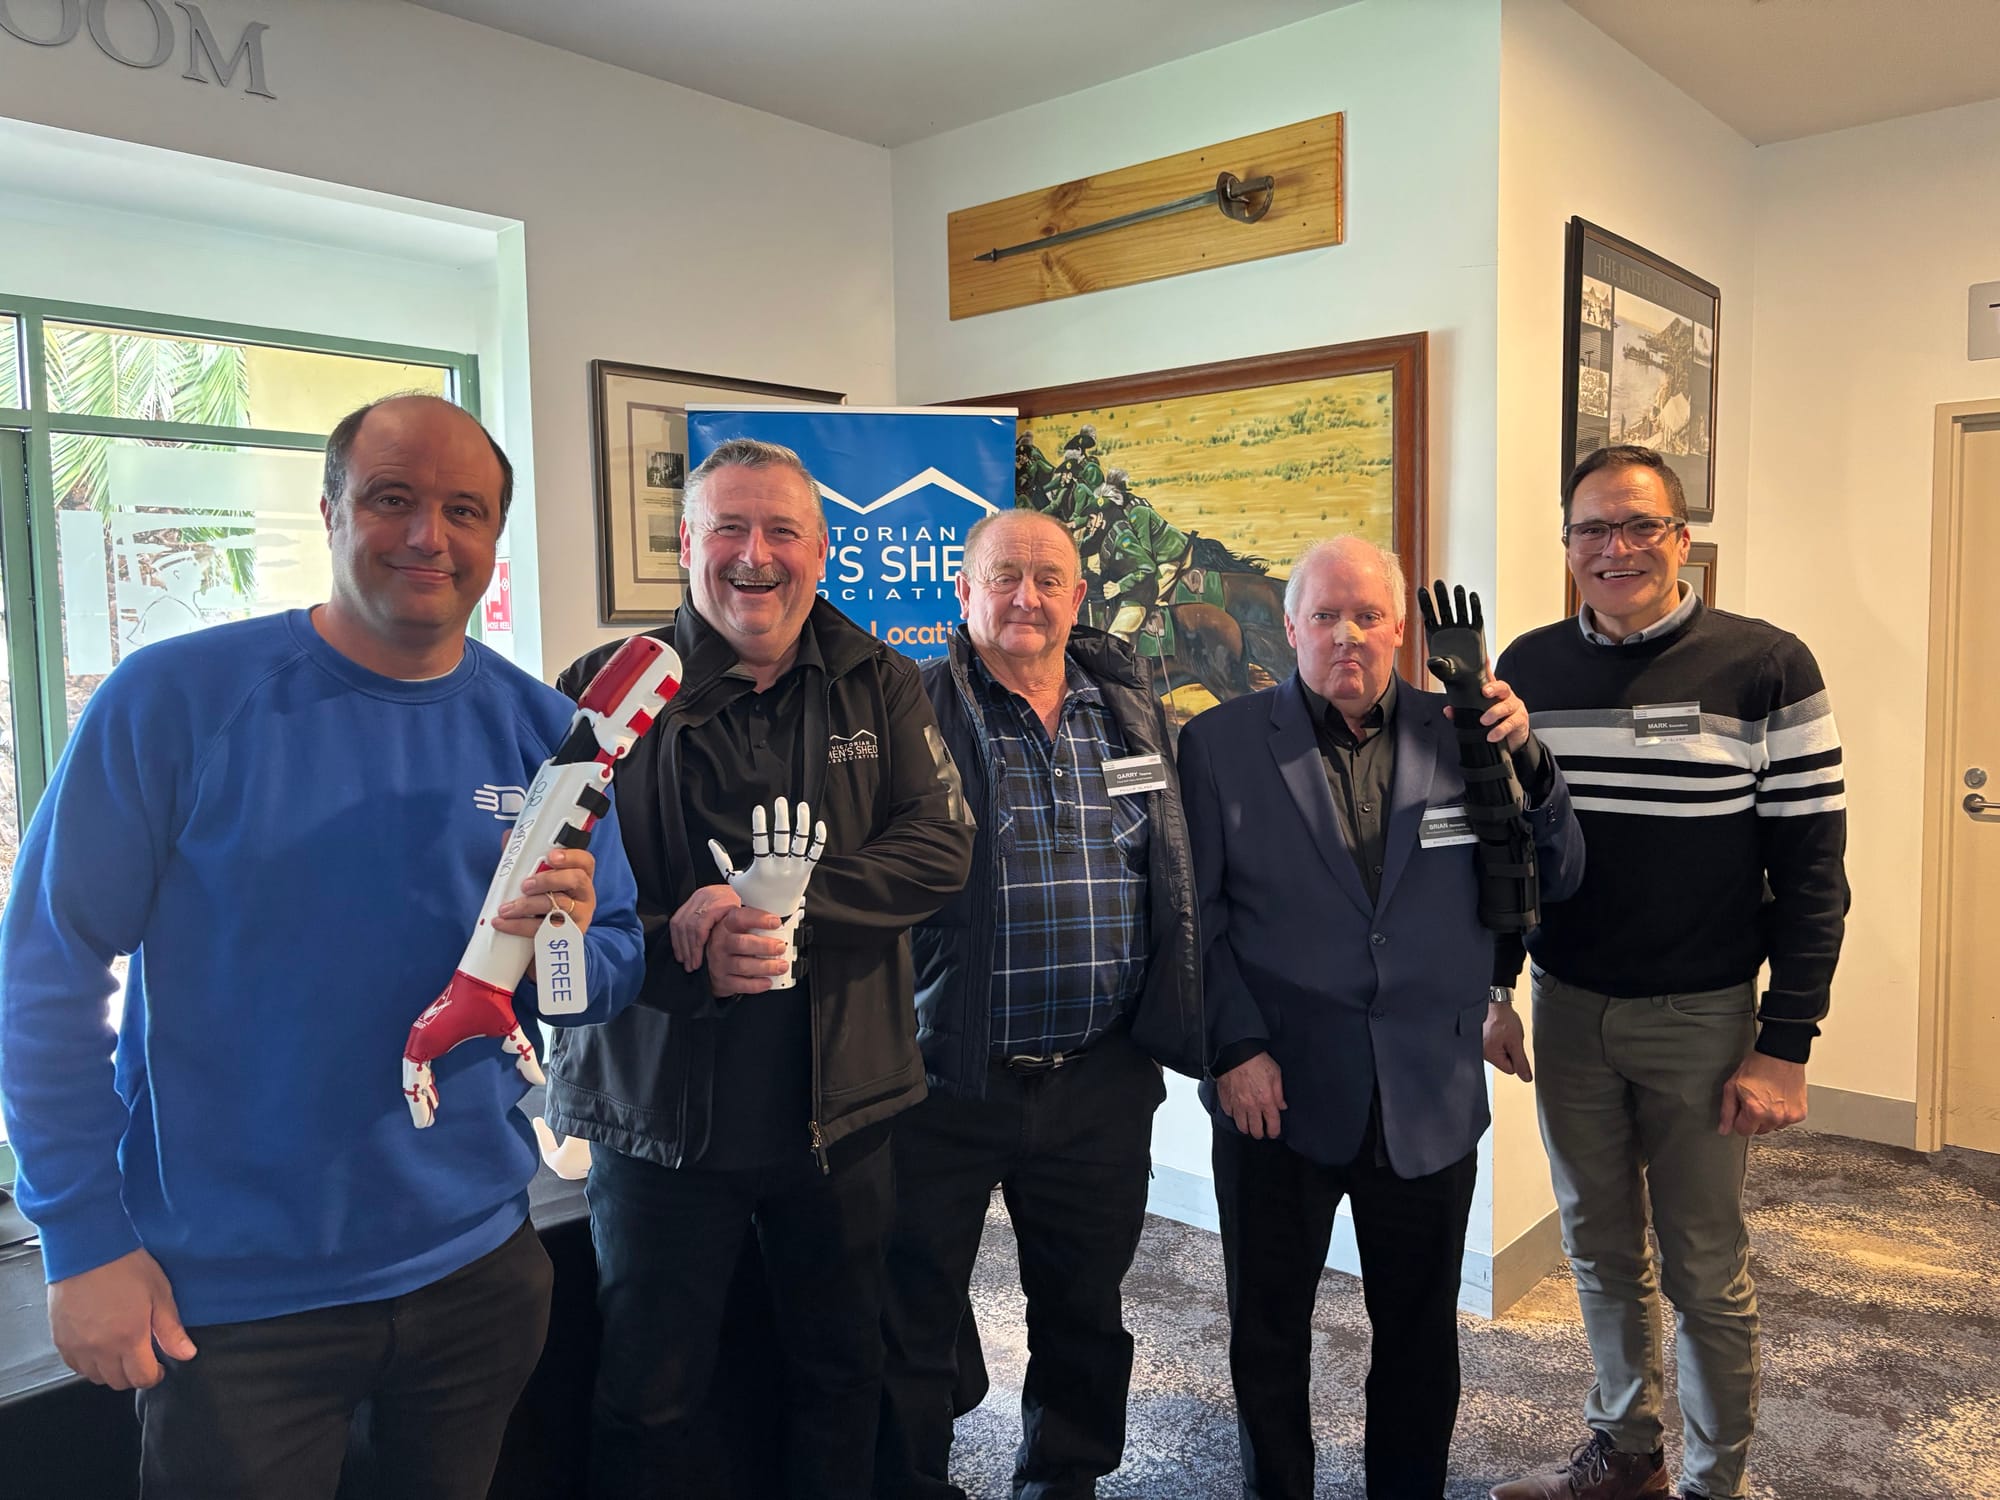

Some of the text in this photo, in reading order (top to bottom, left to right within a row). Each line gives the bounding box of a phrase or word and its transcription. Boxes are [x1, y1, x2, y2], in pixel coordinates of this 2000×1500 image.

[1596, 253, 1617, 281] THE
[820, 545, 865, 583] 'S
[816, 588, 960, 600] OCIATI
[831, 740, 870, 750] VICTORIAN
[855, 745, 878, 755] SHED
[1116, 771, 1138, 780] GARRY
[548, 939, 572, 1003] $FREE
